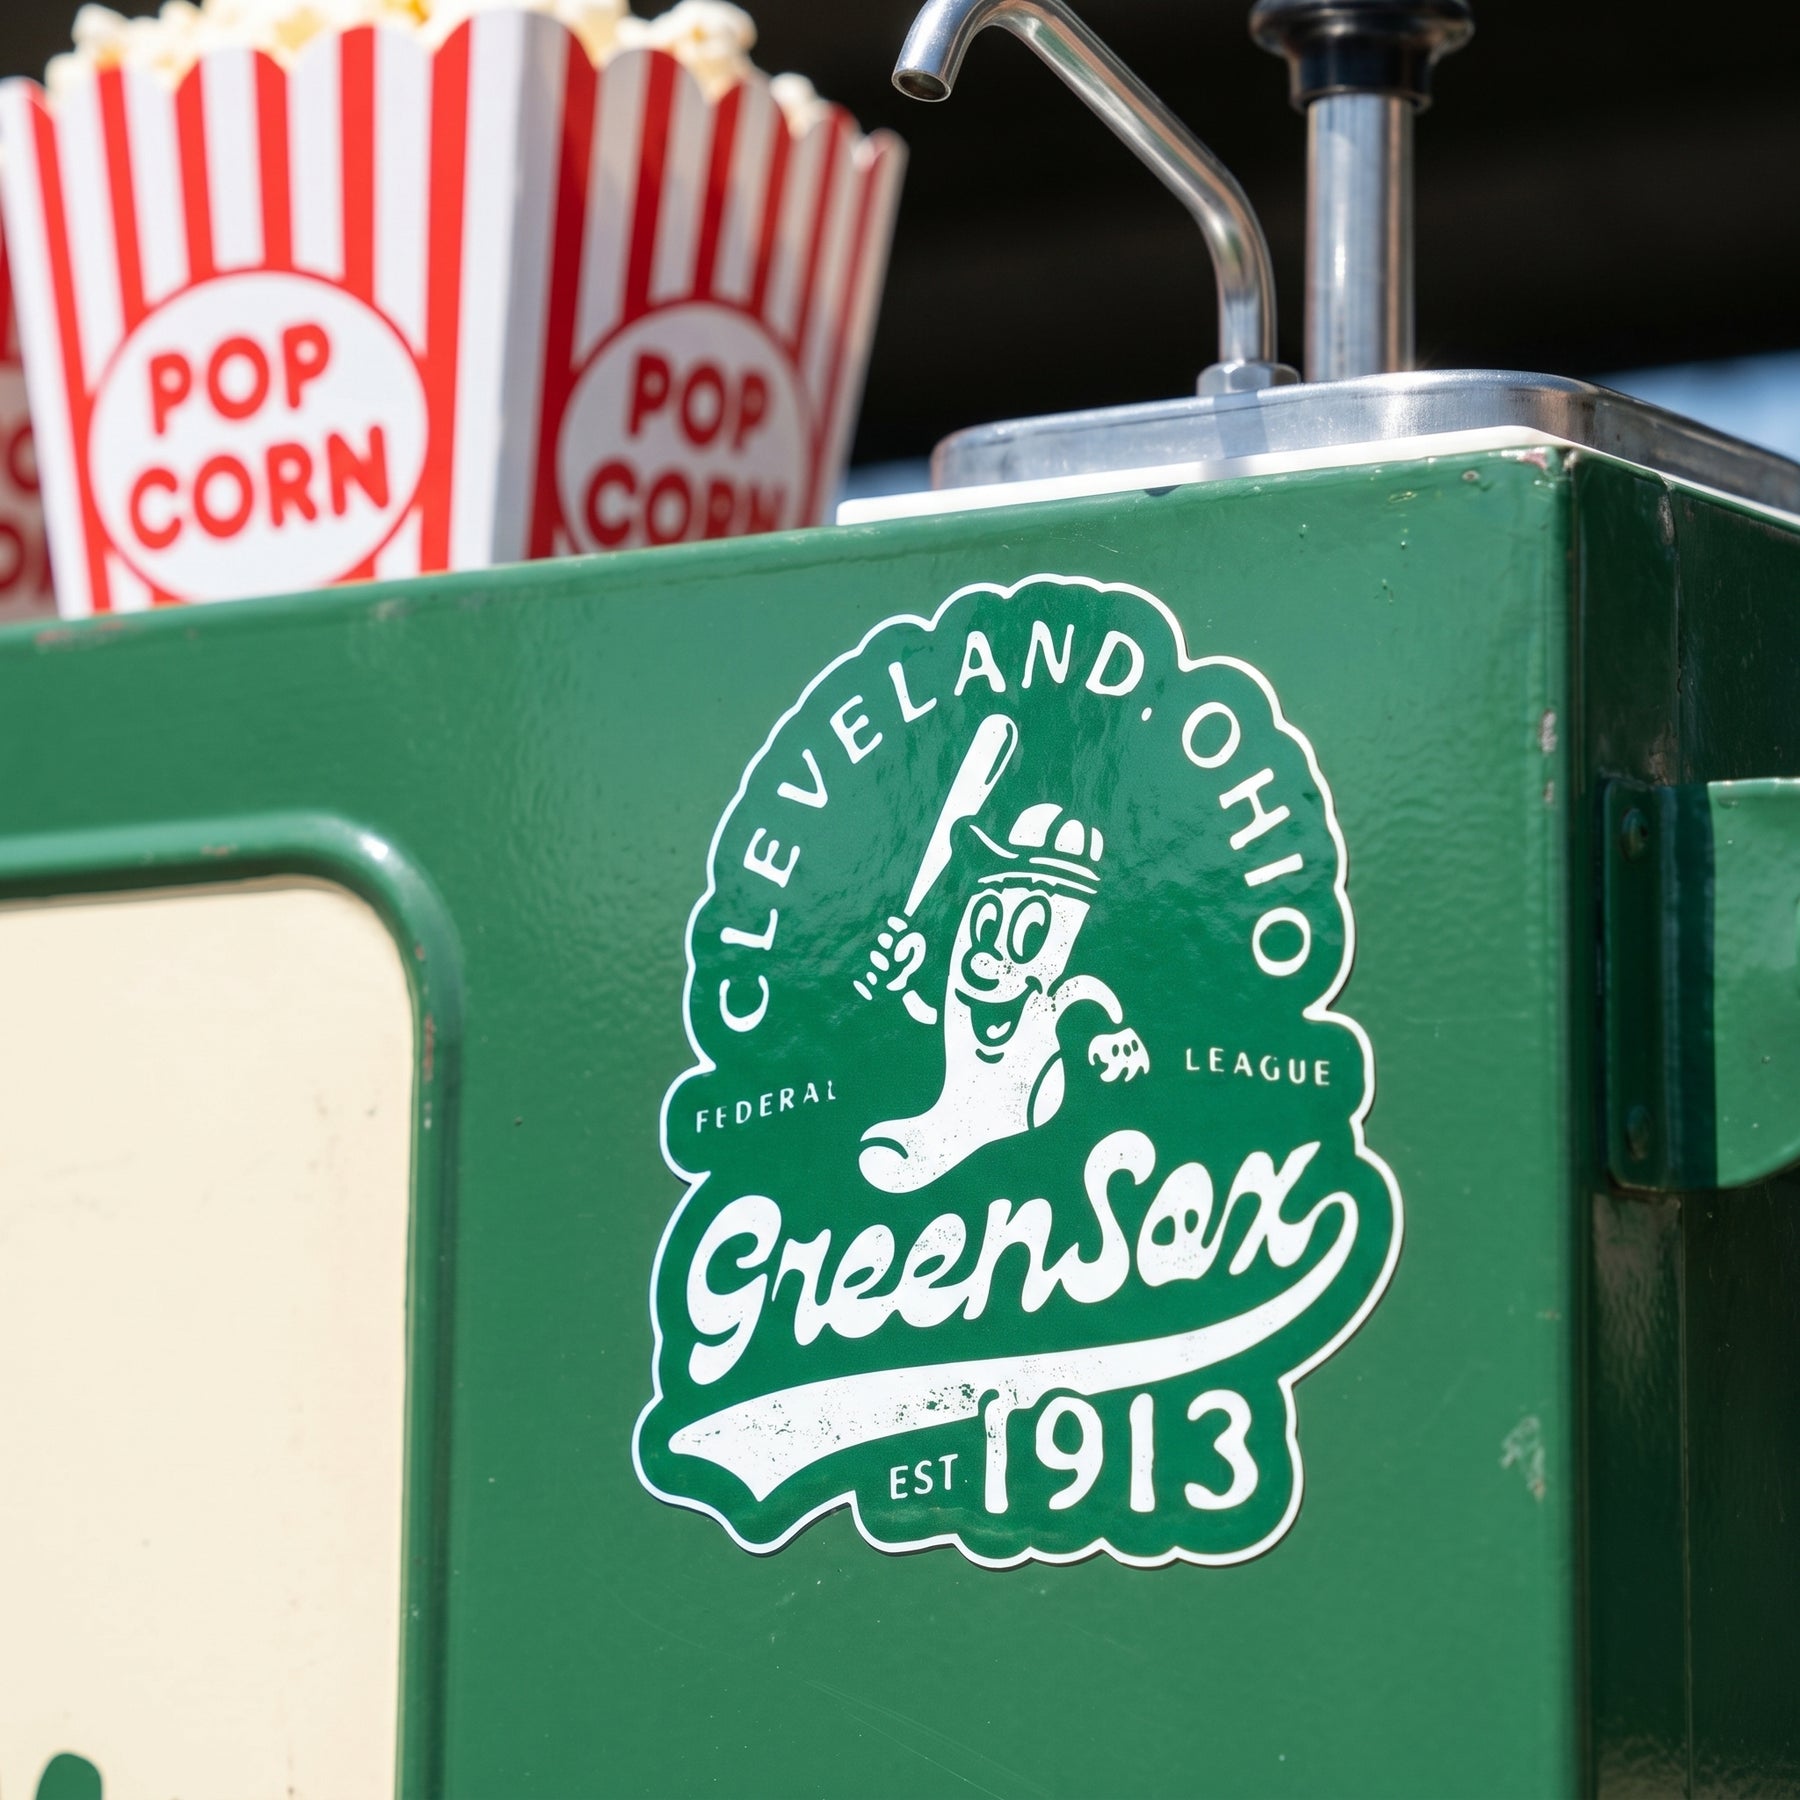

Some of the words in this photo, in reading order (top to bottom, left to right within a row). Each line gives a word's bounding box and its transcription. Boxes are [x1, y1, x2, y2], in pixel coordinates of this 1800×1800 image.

[149, 322, 331, 436] POP
[626, 350, 771, 456] POP
[129, 422, 391, 550] CORN
[1181, 701, 1311, 977] OHIO
[695, 1079, 837, 1133] FEDERAL
[1185, 1047, 1331, 1086] LEAGUE
[984, 1389, 1259, 1514] 1913
